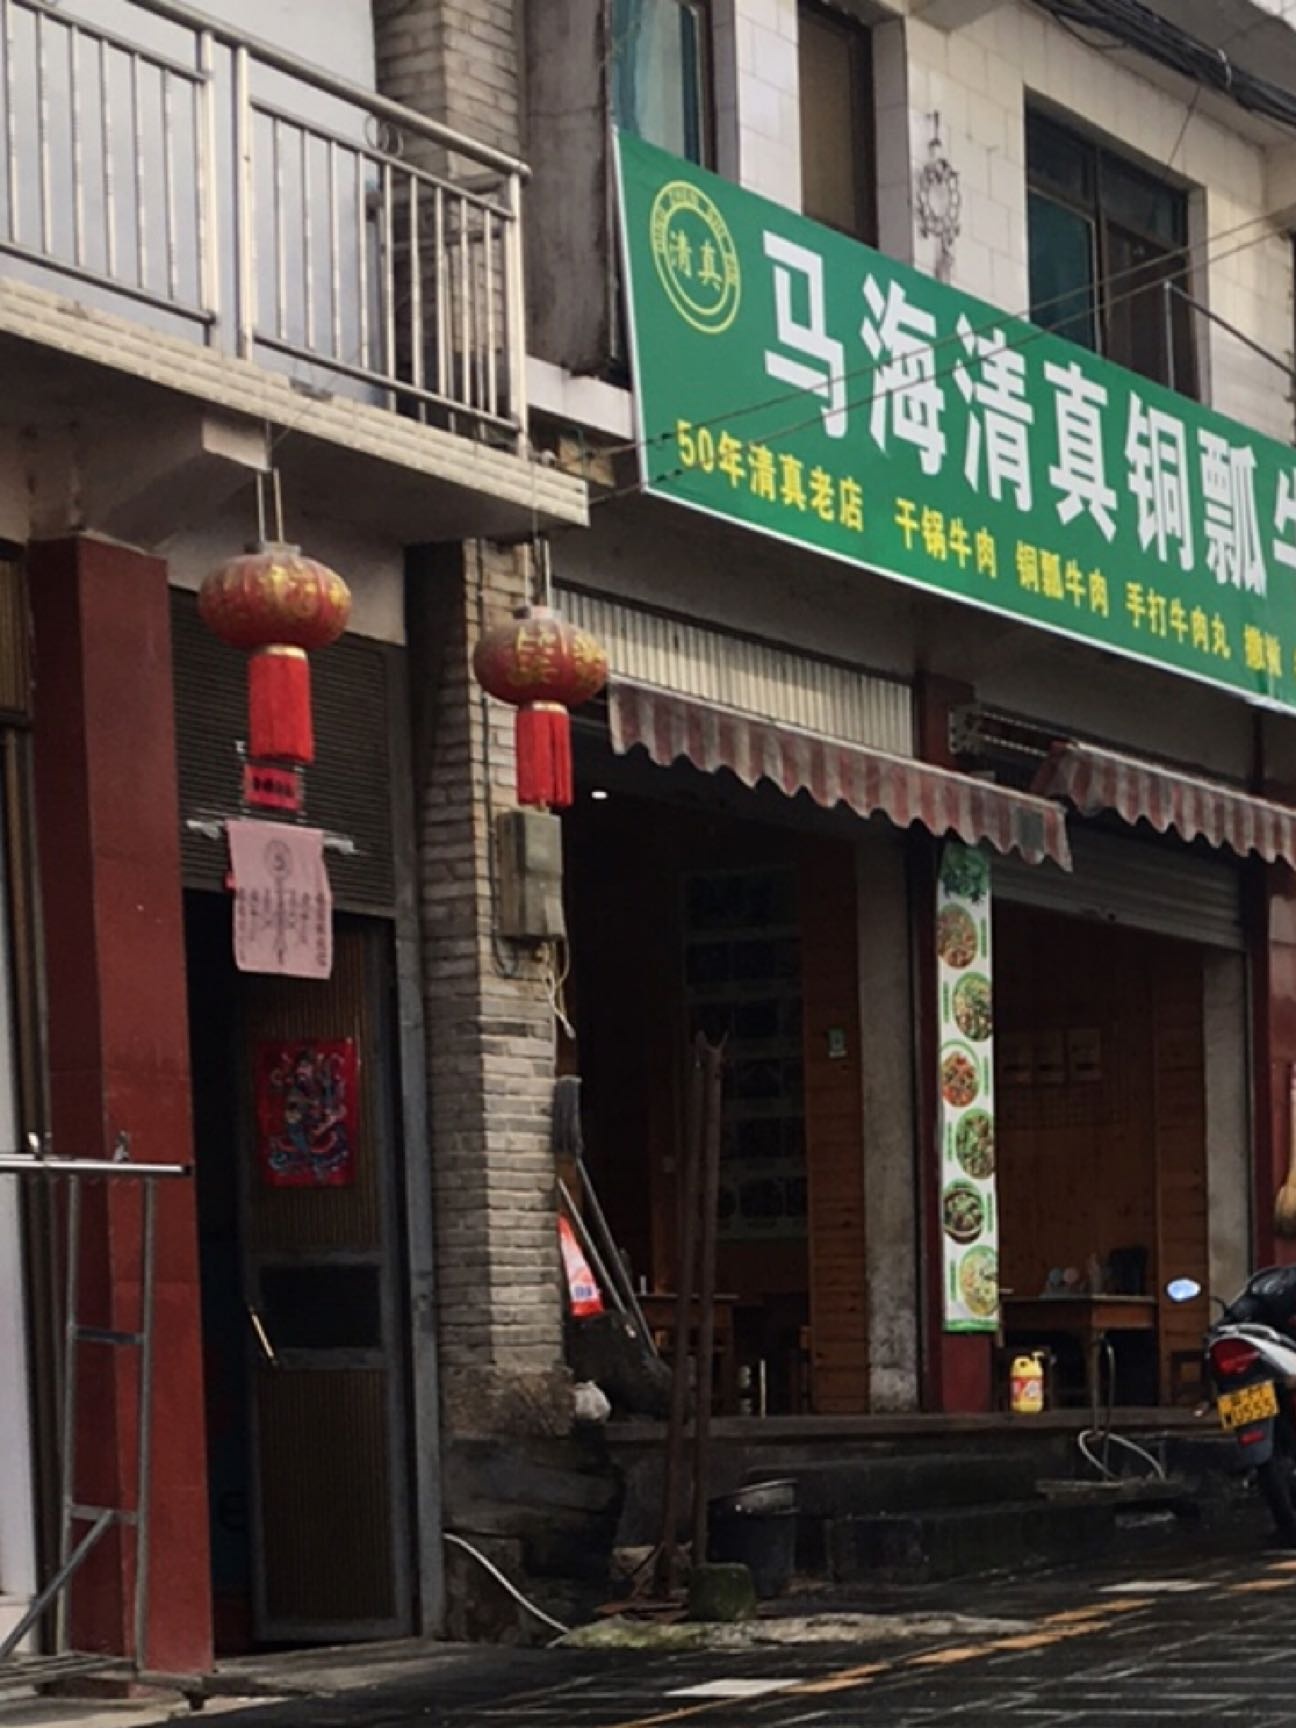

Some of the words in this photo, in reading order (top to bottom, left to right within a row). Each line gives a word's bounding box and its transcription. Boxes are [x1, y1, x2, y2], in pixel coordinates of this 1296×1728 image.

[676, 418, 864, 532] 50年清真老店
[895, 496, 998, 578] 干锅牛肉
[1126, 581, 1231, 661] 手打牛肉丸
